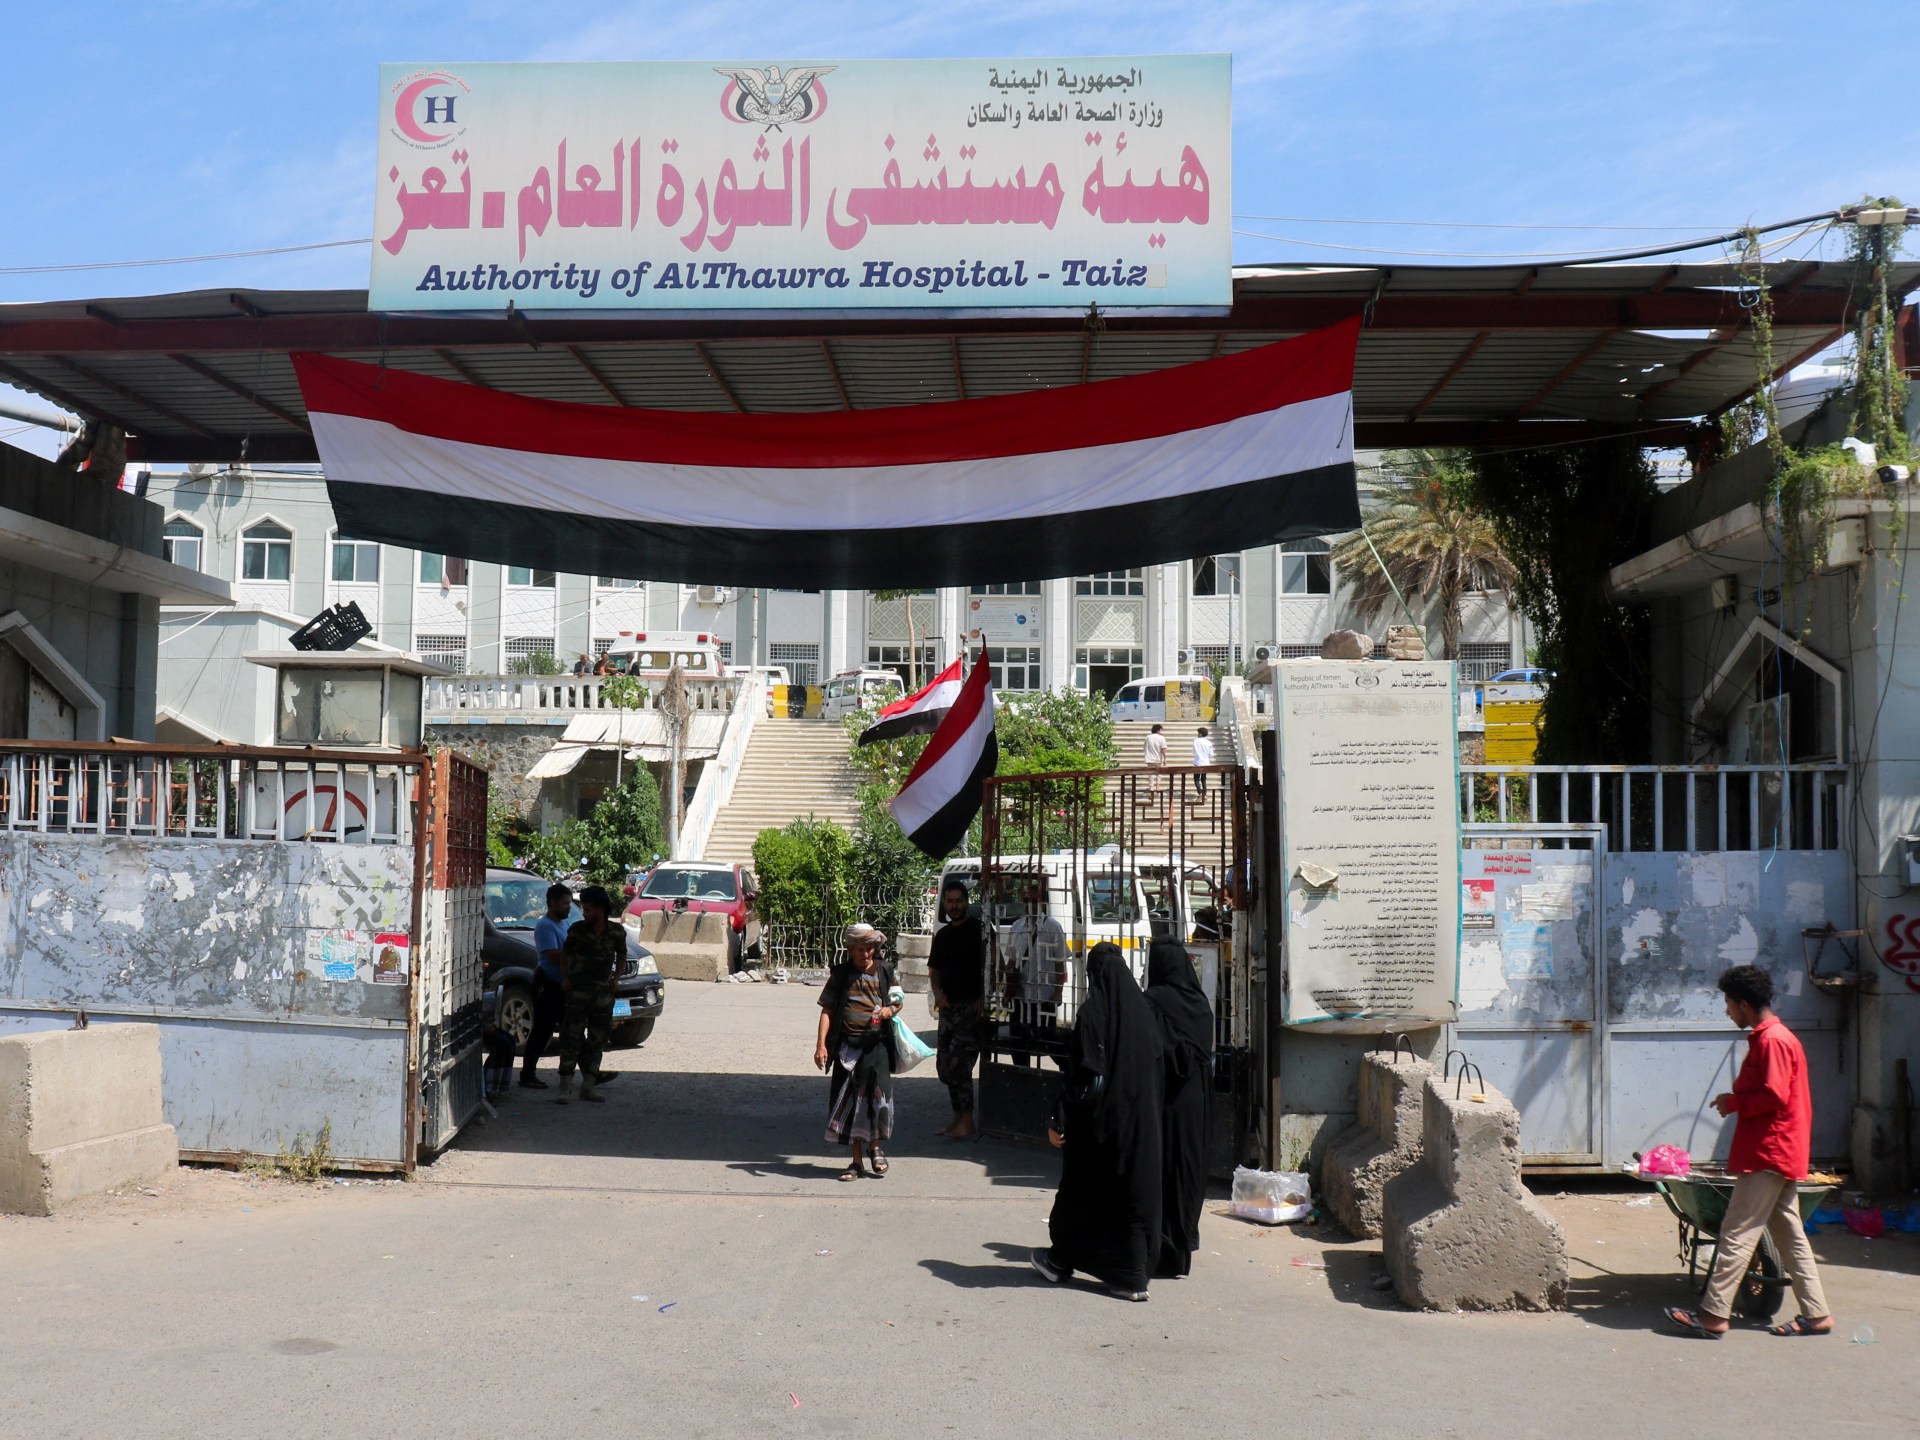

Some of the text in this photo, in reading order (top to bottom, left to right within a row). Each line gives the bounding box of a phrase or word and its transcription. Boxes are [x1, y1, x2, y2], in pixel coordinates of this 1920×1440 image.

[989, 67, 1142, 95] الجمهورية اليمنية
[424, 96, 458, 123] H
[967, 102, 1163, 128] وزارة الصحة العامة والسكان
[656, 133, 810, 252] الثورة
[826, 132, 1065, 251] مستشفى
[1082, 131, 1210, 249] هيئة
[380, 148, 471, 256] تعز
[517, 136, 640, 264] العام
[416, 263, 600, 298] Authority
[611, 261, 651, 298] of
[654, 261, 850, 290] AlThawra
[859, 259, 1029, 294] Hospital
[1061, 259, 1149, 288] Taiz
[1290, 673, 1342, 683] Republic of Yemen
[1401, 669, 1434, 679] الجمهورية اليمنية
[1284, 683, 1309, 691] Authority
[1410, 680, 1421, 689] الثورة
[1422, 680, 1437, 689] مستشفى
[1505, 854, 1514, 862] الله
[1514, 854, 1531, 863] سبحان
[1484, 866, 1503, 874] العظيم
[1514, 866, 1531, 874] سبحان
